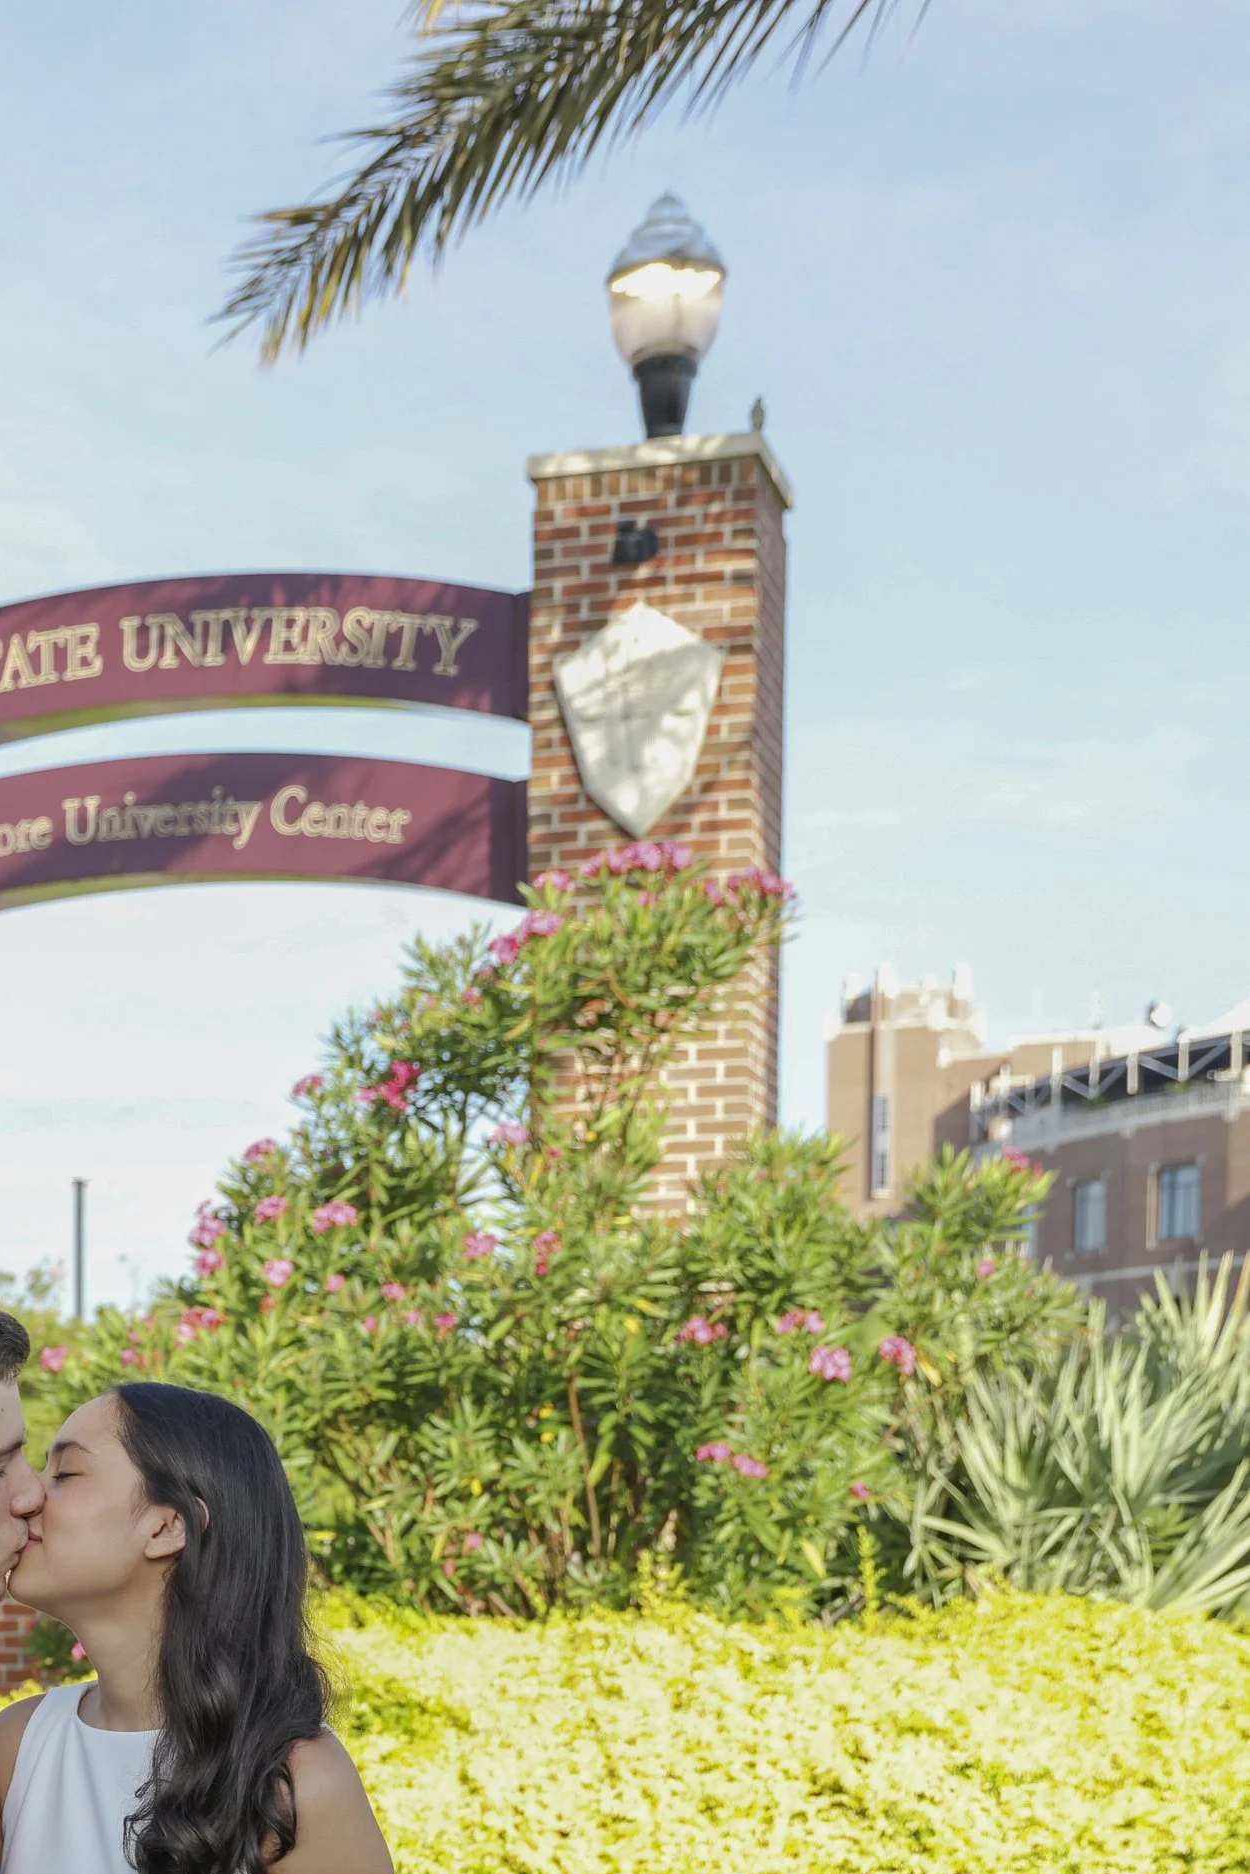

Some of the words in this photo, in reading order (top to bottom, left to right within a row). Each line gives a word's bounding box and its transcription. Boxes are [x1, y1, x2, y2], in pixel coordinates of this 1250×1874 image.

[119, 606, 478, 676] UNIVERSITY
[62, 785, 263, 850] University
[269, 784, 413, 845] Center
